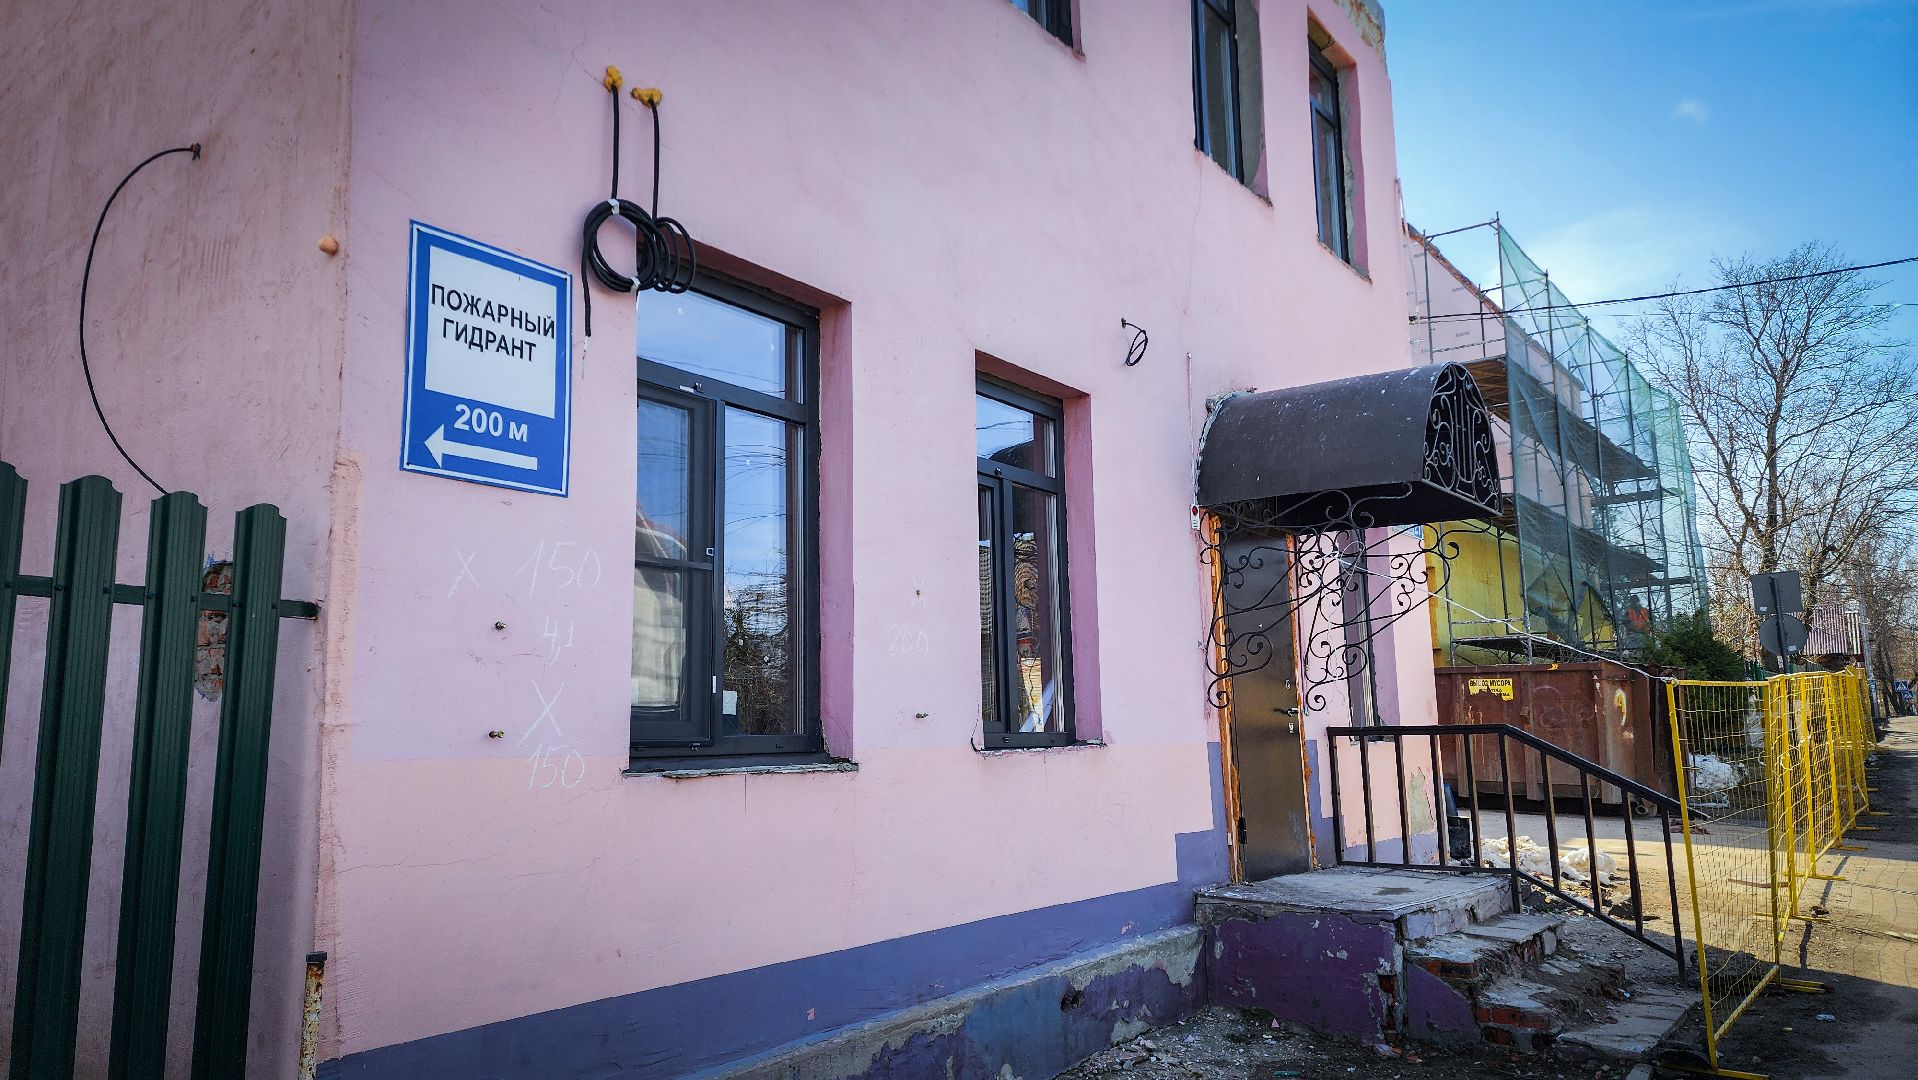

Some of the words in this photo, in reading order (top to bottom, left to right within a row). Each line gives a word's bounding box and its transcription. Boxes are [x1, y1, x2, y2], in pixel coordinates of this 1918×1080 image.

[431, 283, 555, 339] ПОЖАРНЫЙ
[442, 318, 537, 361] ГИДРАНТ
[453, 404, 503, 437] 200
[514, 540, 601, 598] 150
[527, 742, 585, 789] 150
